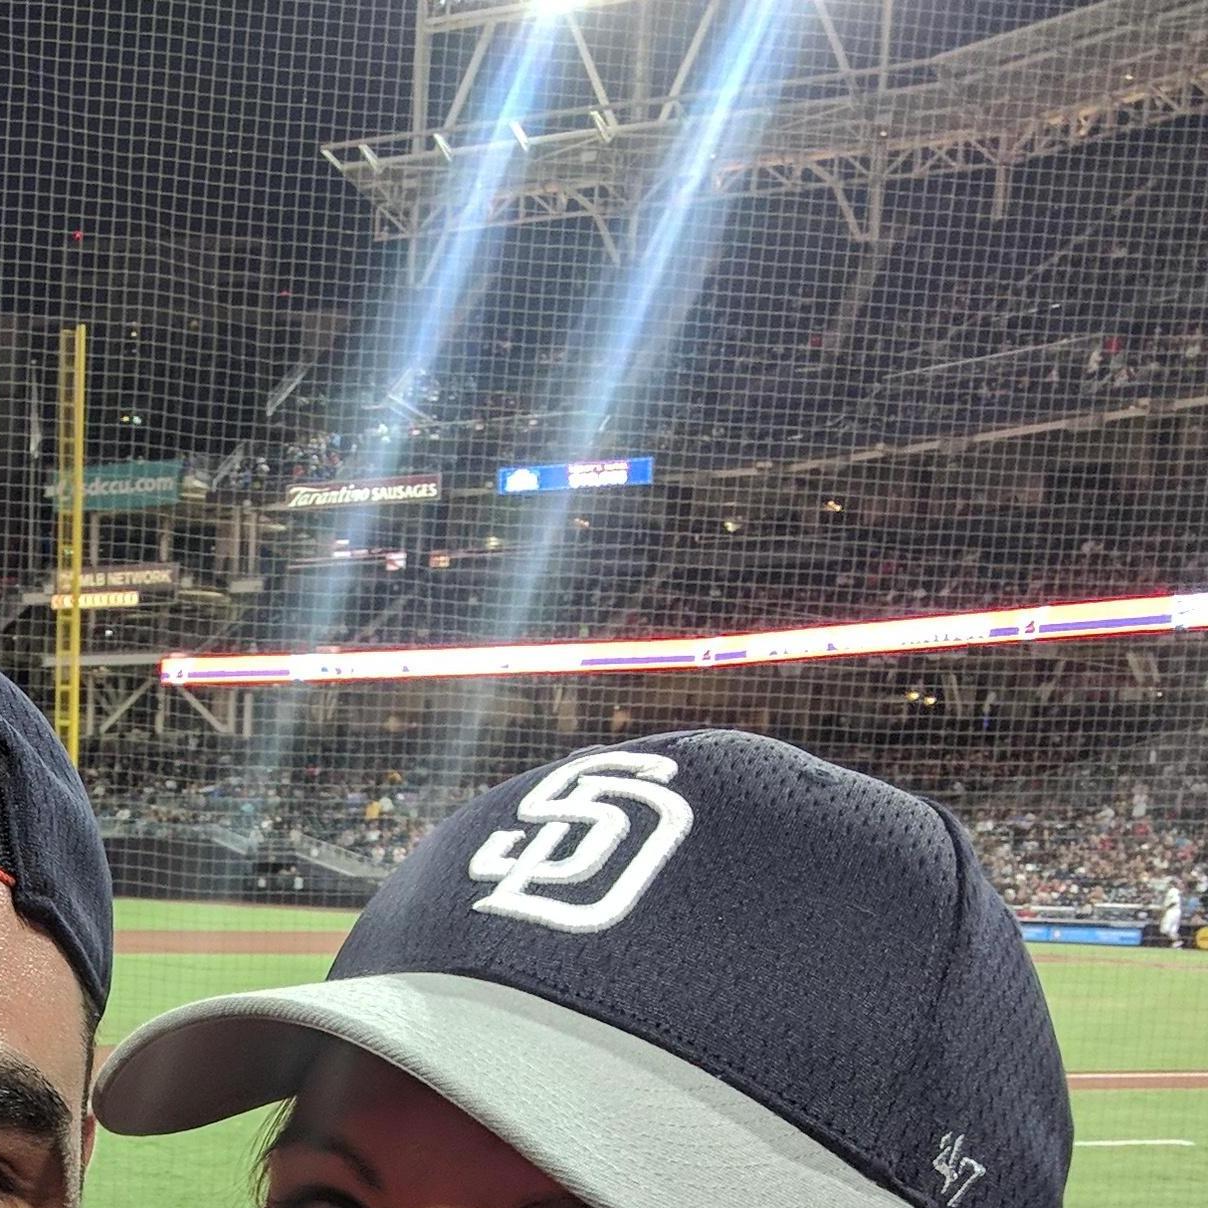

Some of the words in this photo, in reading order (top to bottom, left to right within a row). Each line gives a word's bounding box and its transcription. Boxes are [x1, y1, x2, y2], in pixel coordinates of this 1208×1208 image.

[288, 484, 371, 507] Tarantino
[371, 483, 438, 501] SAUSAGES
[107, 569, 173, 585] NETWORK
[468, 750, 695, 934] SD
